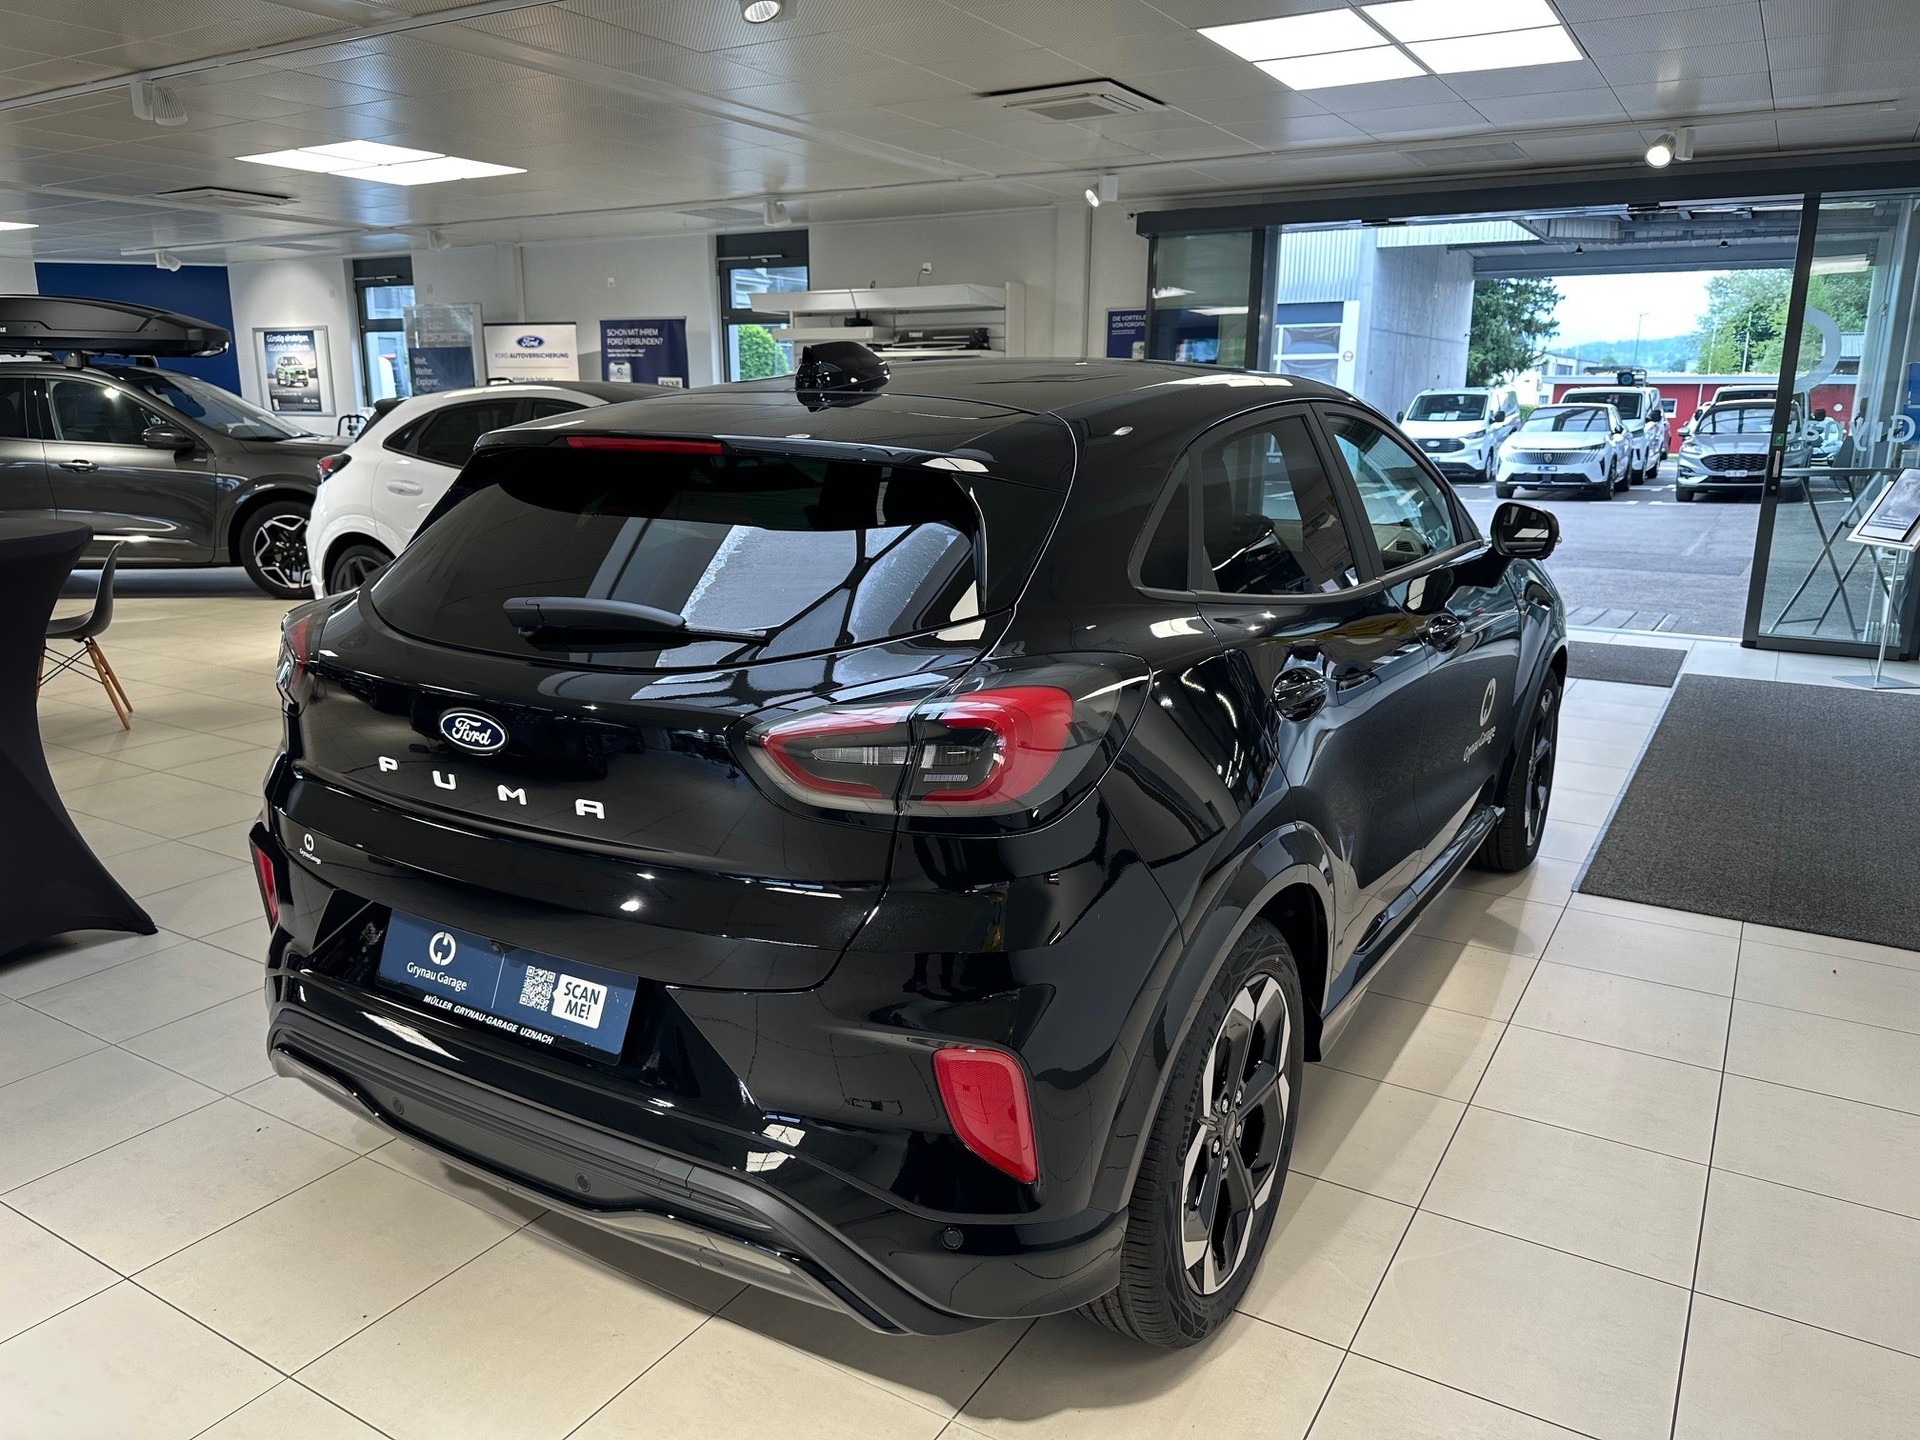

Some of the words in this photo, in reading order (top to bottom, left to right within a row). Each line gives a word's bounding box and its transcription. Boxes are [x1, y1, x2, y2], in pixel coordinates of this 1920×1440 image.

[607, 337, 624, 346] FORD
[450, 716, 494, 746] Ford
[379, 756, 606, 819] PUMA
[406, 961, 437, 980] Grynau
[437, 971, 467, 992] Garage
[563, 981, 601, 1005] SCAN
[423, 994, 453, 1010] MÜLLER
[454, 1005, 518, 1033] GRYNAU-GARAGE
[519, 1026, 554, 1045] UZNACH
[564, 1001, 592, 1020] ME!
